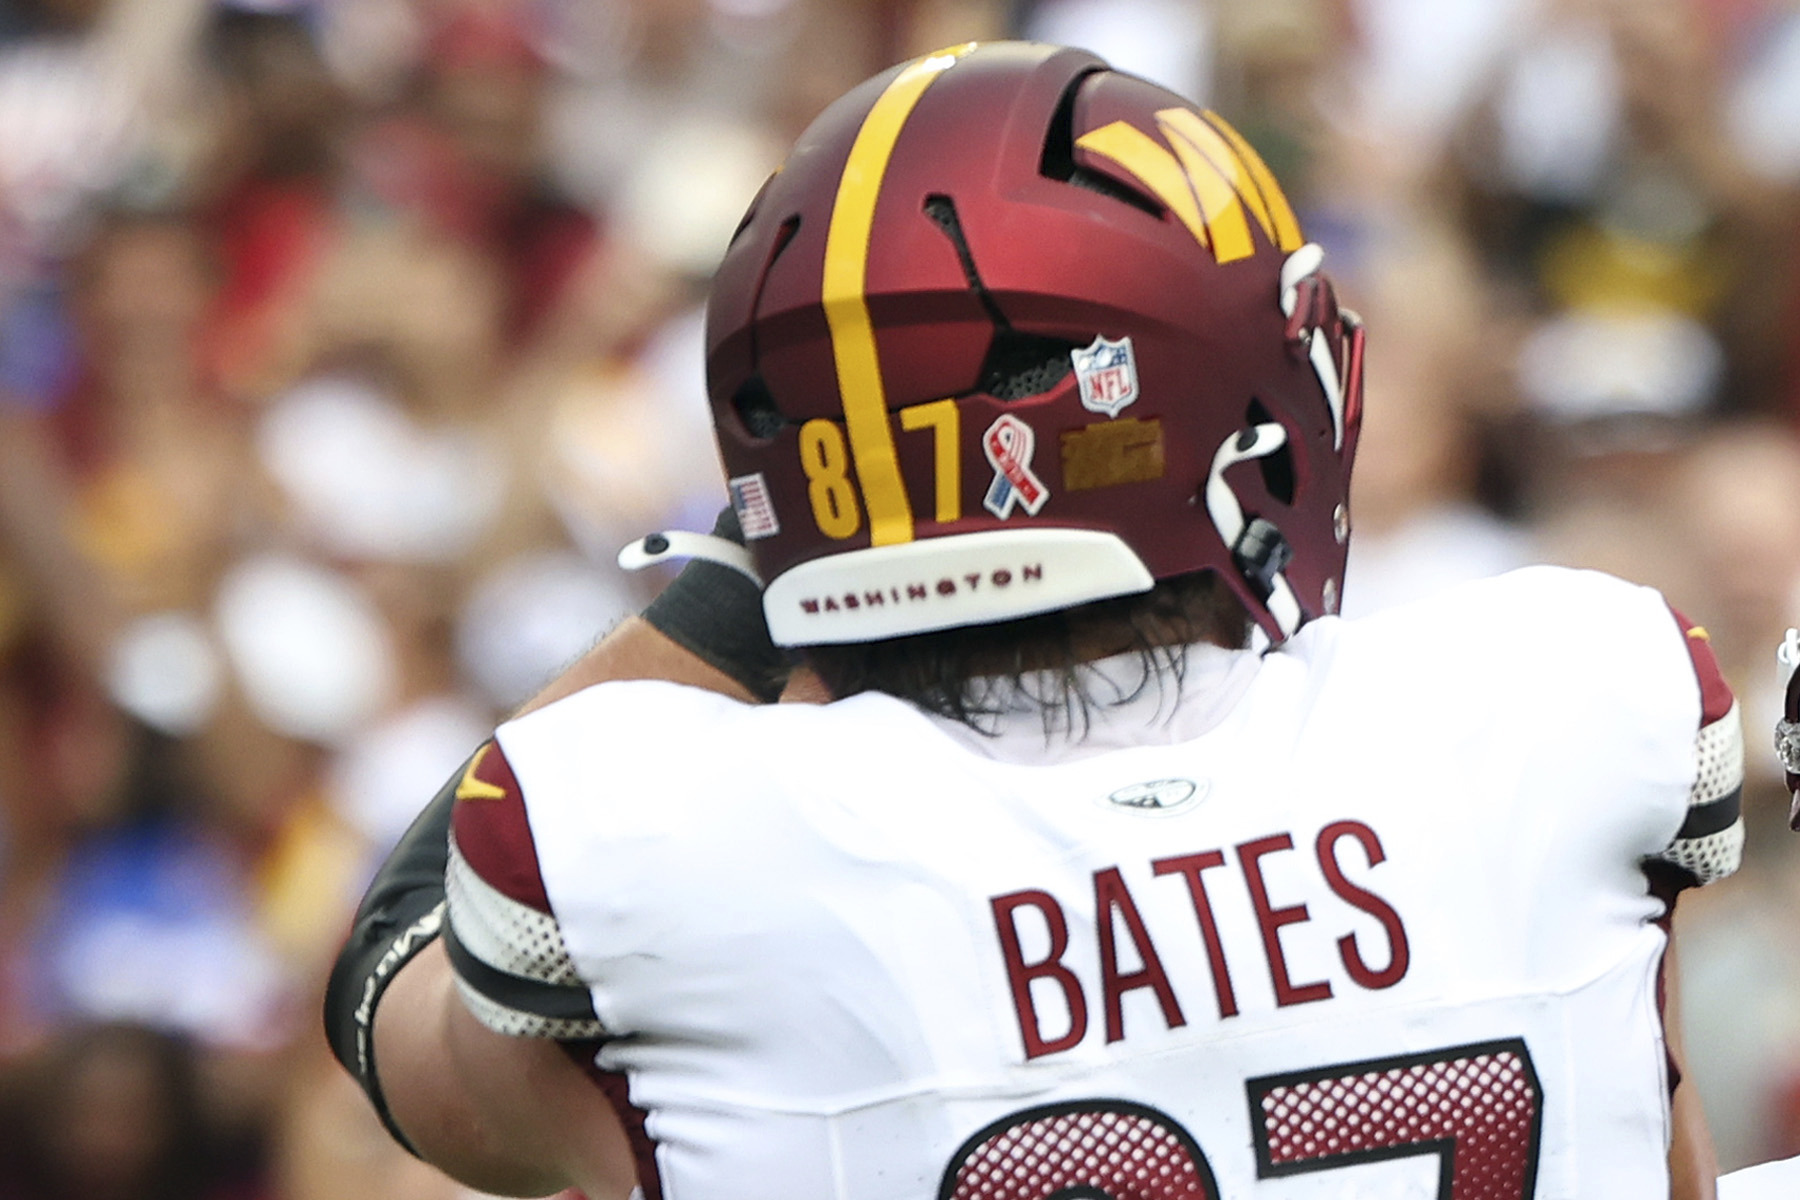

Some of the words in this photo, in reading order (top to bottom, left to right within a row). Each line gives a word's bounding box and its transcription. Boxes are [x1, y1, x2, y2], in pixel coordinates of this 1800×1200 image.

[1089, 368, 1131, 401] NFL
[799, 563, 1044, 615] WASHINGTON
[987, 818, 1411, 1061] BATES
